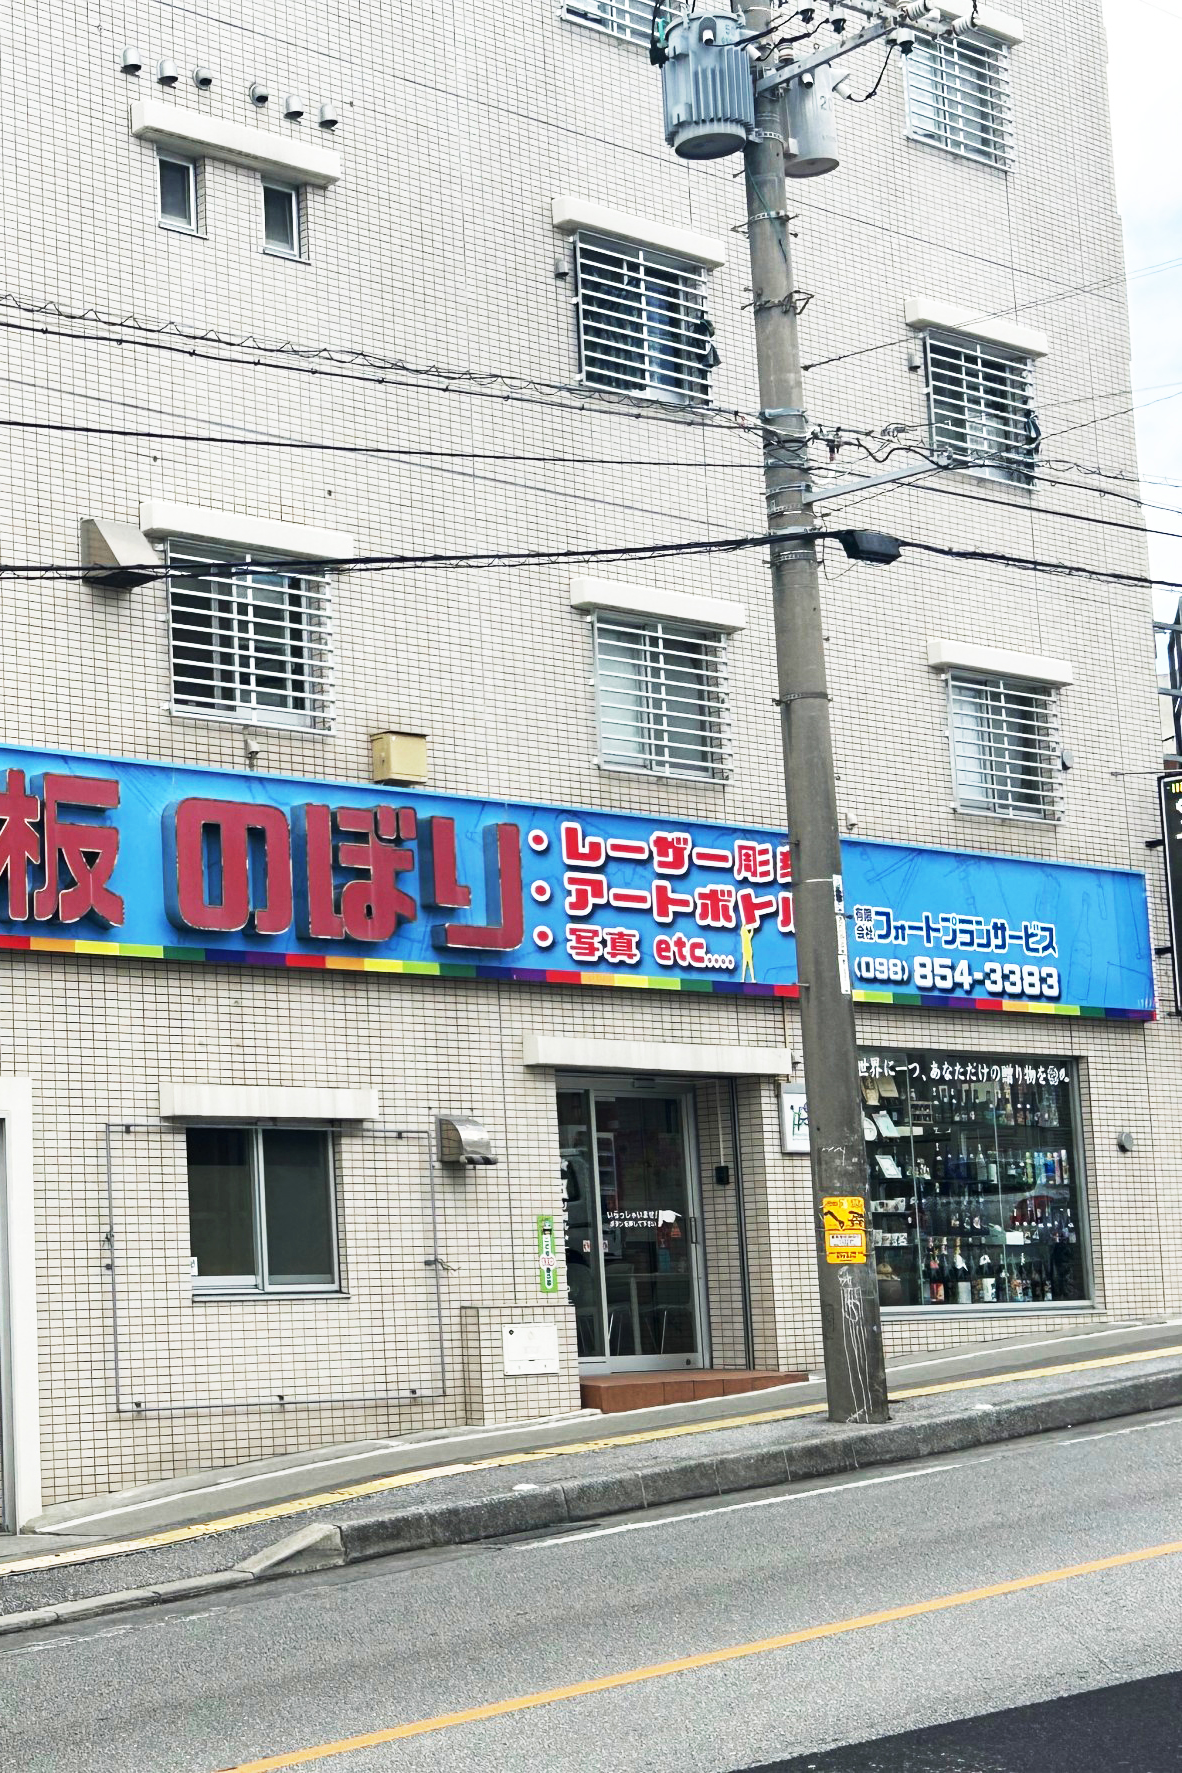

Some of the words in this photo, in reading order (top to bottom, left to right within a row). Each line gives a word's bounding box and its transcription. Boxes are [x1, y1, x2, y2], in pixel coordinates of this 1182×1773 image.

[166, 796, 524, 952] のぼり
[566, 923, 641, 964] 写真
[874, 909, 1058, 957] フォートプランサービス
[854, 956, 909, 982] (098)
[913, 955, 1060, 998] 854-3383
